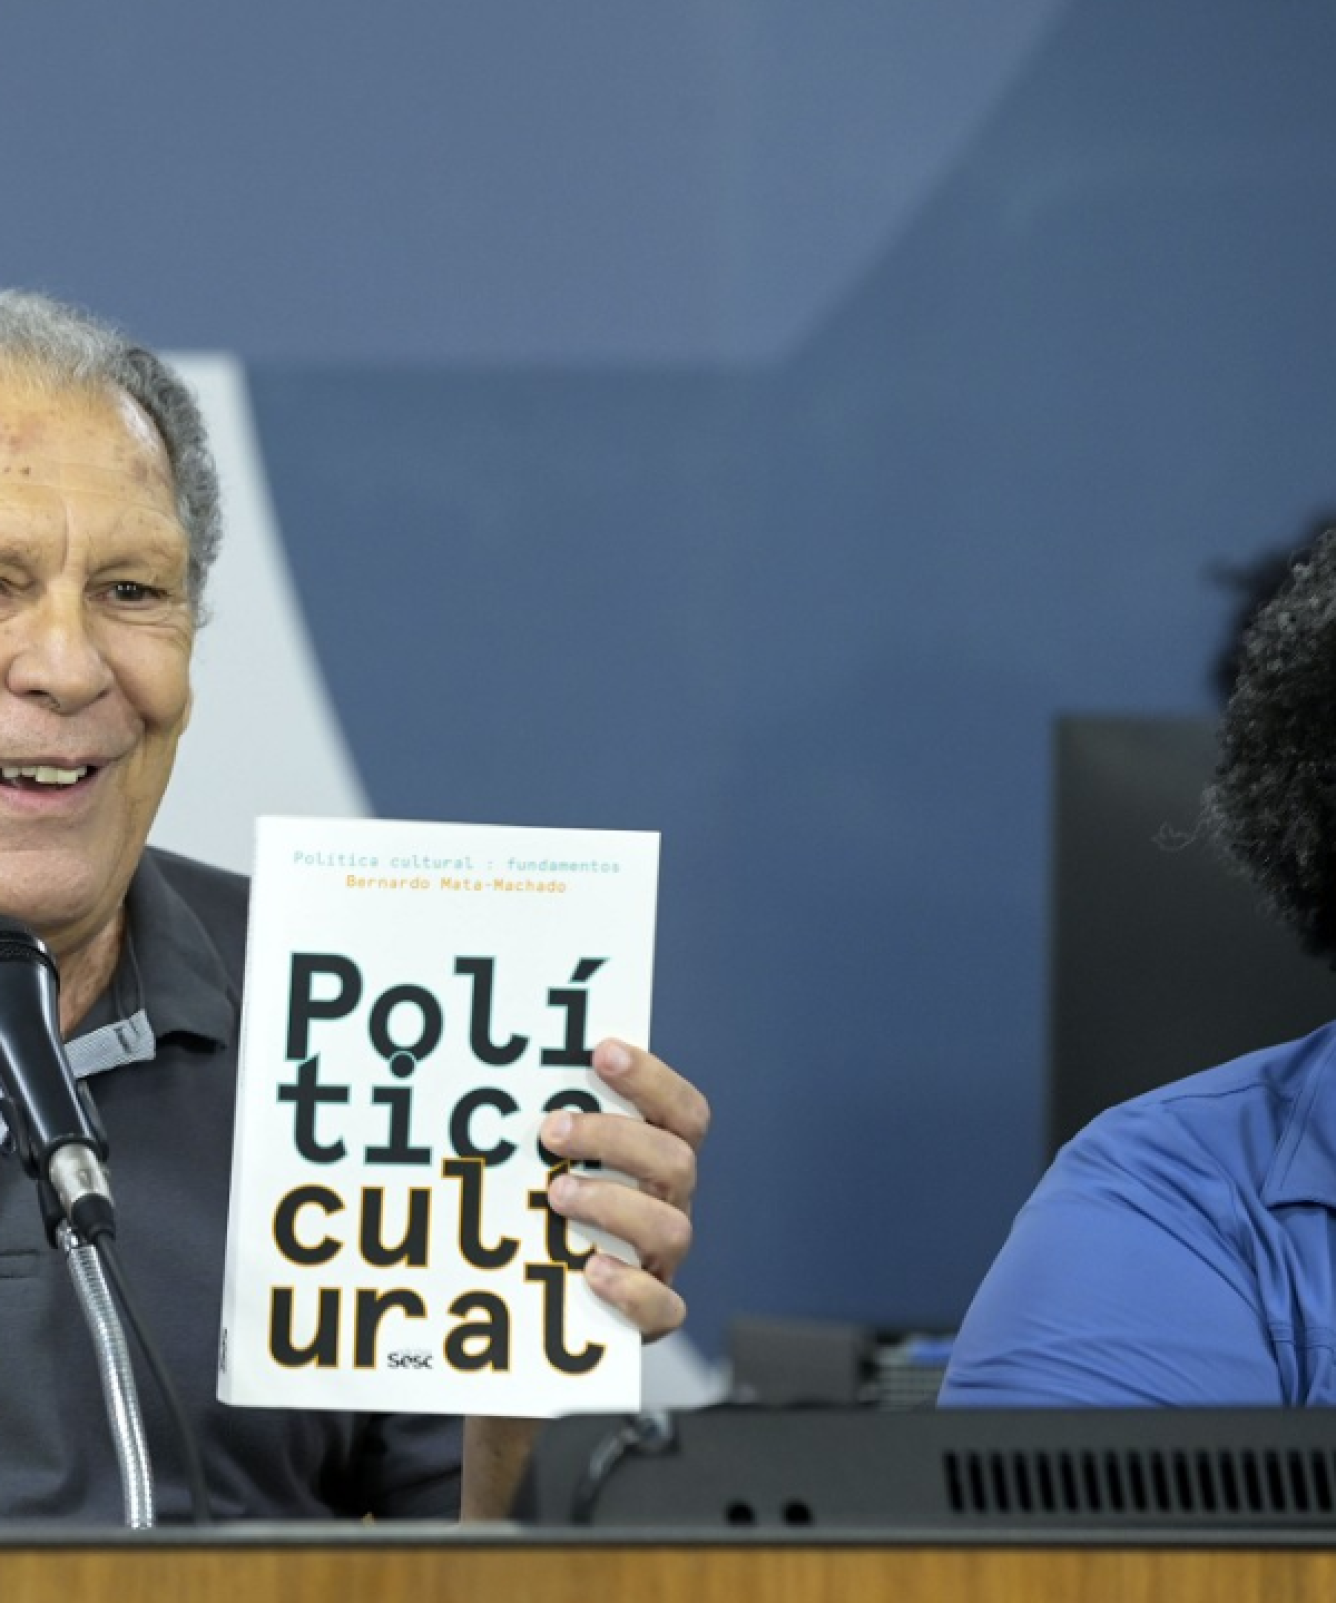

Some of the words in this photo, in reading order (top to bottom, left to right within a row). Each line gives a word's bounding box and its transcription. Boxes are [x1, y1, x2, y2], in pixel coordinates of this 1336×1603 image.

[345, 874, 430, 890] Bernardo
[440, 876, 568, 894] Mata-Machado
[390, 853, 473, 870] cultural
[507, 856, 621, 874] fundamentos
[284, 951, 609, 1068] Polí
[268, 1262, 607, 1376] ural
